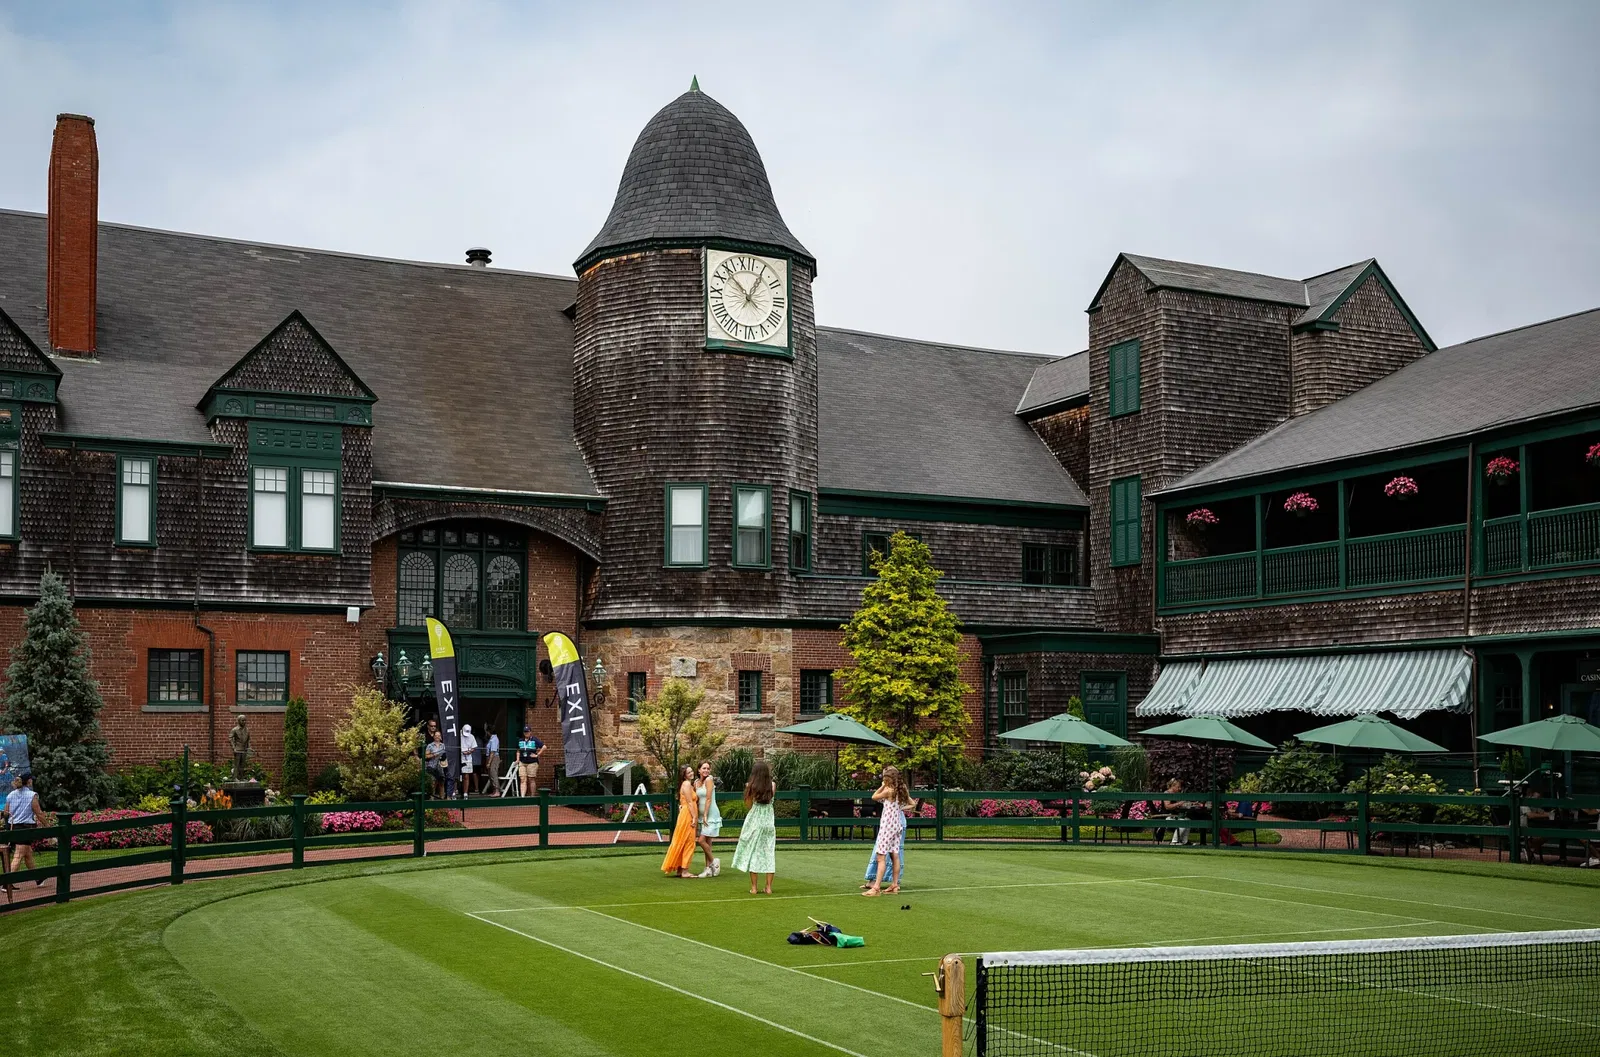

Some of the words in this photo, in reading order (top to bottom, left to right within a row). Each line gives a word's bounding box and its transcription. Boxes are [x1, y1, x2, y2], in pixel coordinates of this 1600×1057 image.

[721, 259, 737, 274] XI
[738, 257, 756, 271] XII
[713, 271, 727, 284] X
[769, 279, 781, 290] II
[710, 286, 723, 299] IX
[773, 297, 785, 309] III
[712, 302, 728, 324] VIII
[767, 310, 782, 328] IIII
[723, 317, 738, 336] VII
[744, 326, 756, 340] VI
[760, 324, 769, 338] V
[441, 680, 457, 737] EXIT
[566, 682, 586, 736] EXIT
